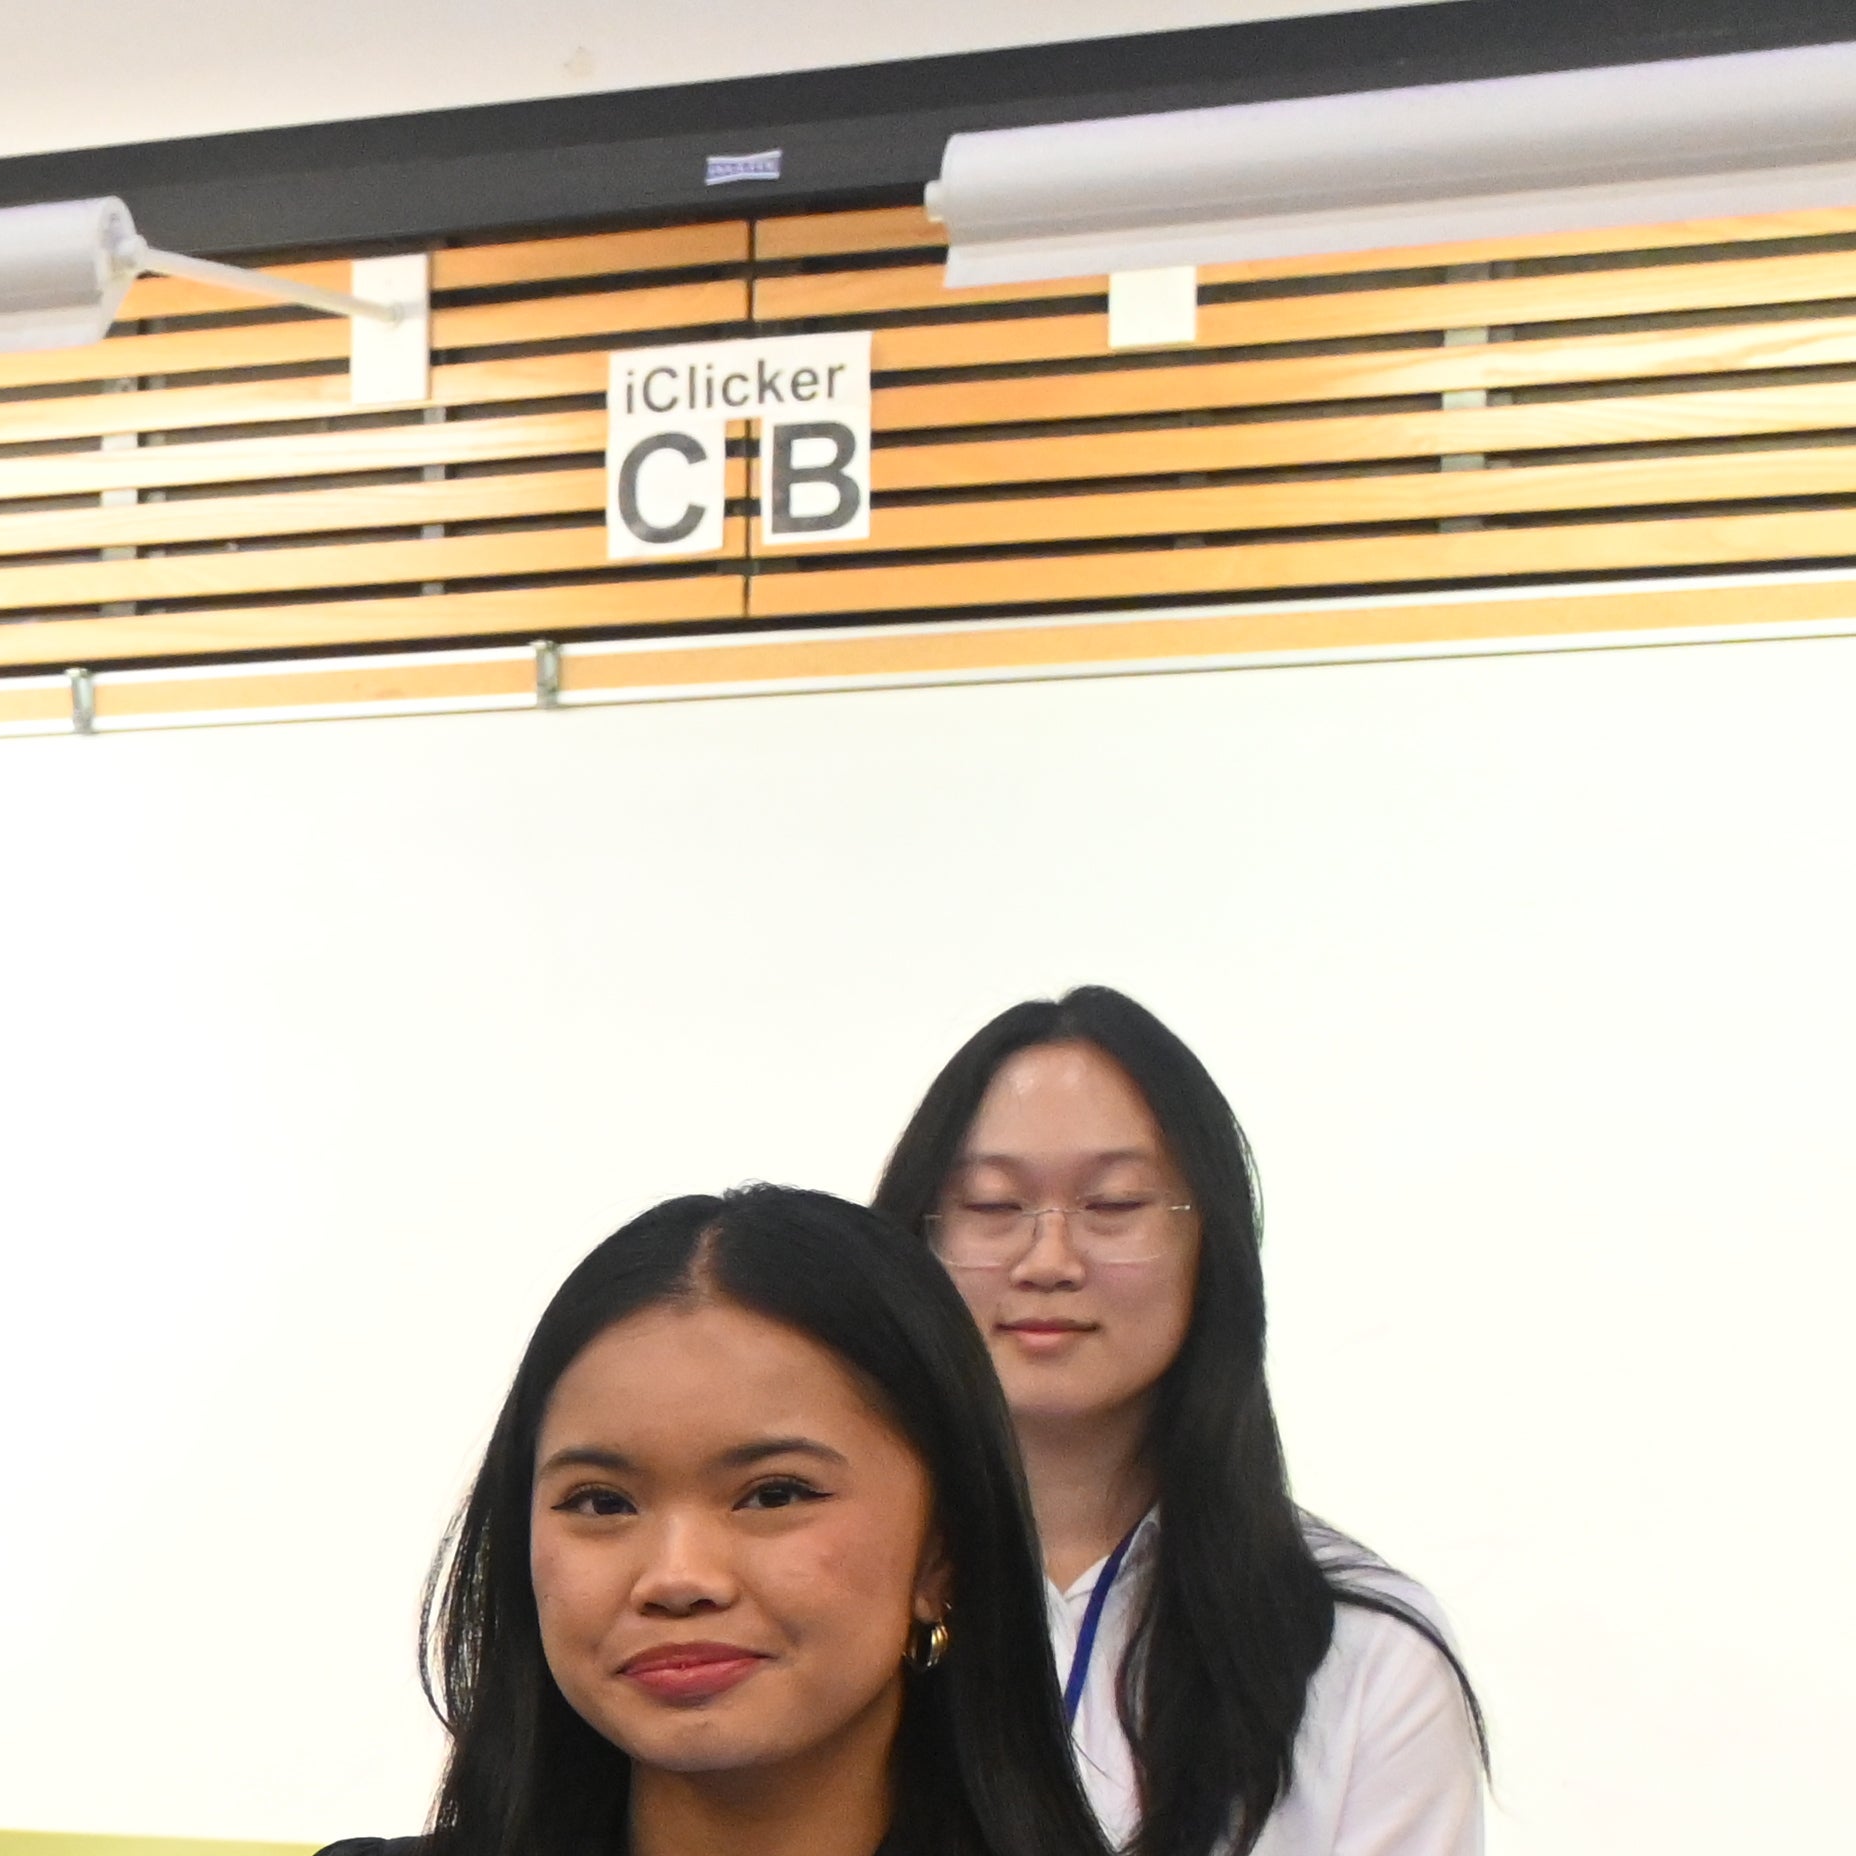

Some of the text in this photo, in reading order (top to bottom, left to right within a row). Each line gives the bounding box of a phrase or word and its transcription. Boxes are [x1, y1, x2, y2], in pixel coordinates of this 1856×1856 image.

[624, 358, 846, 414] iClicker
[618, 420, 861, 544] C B
